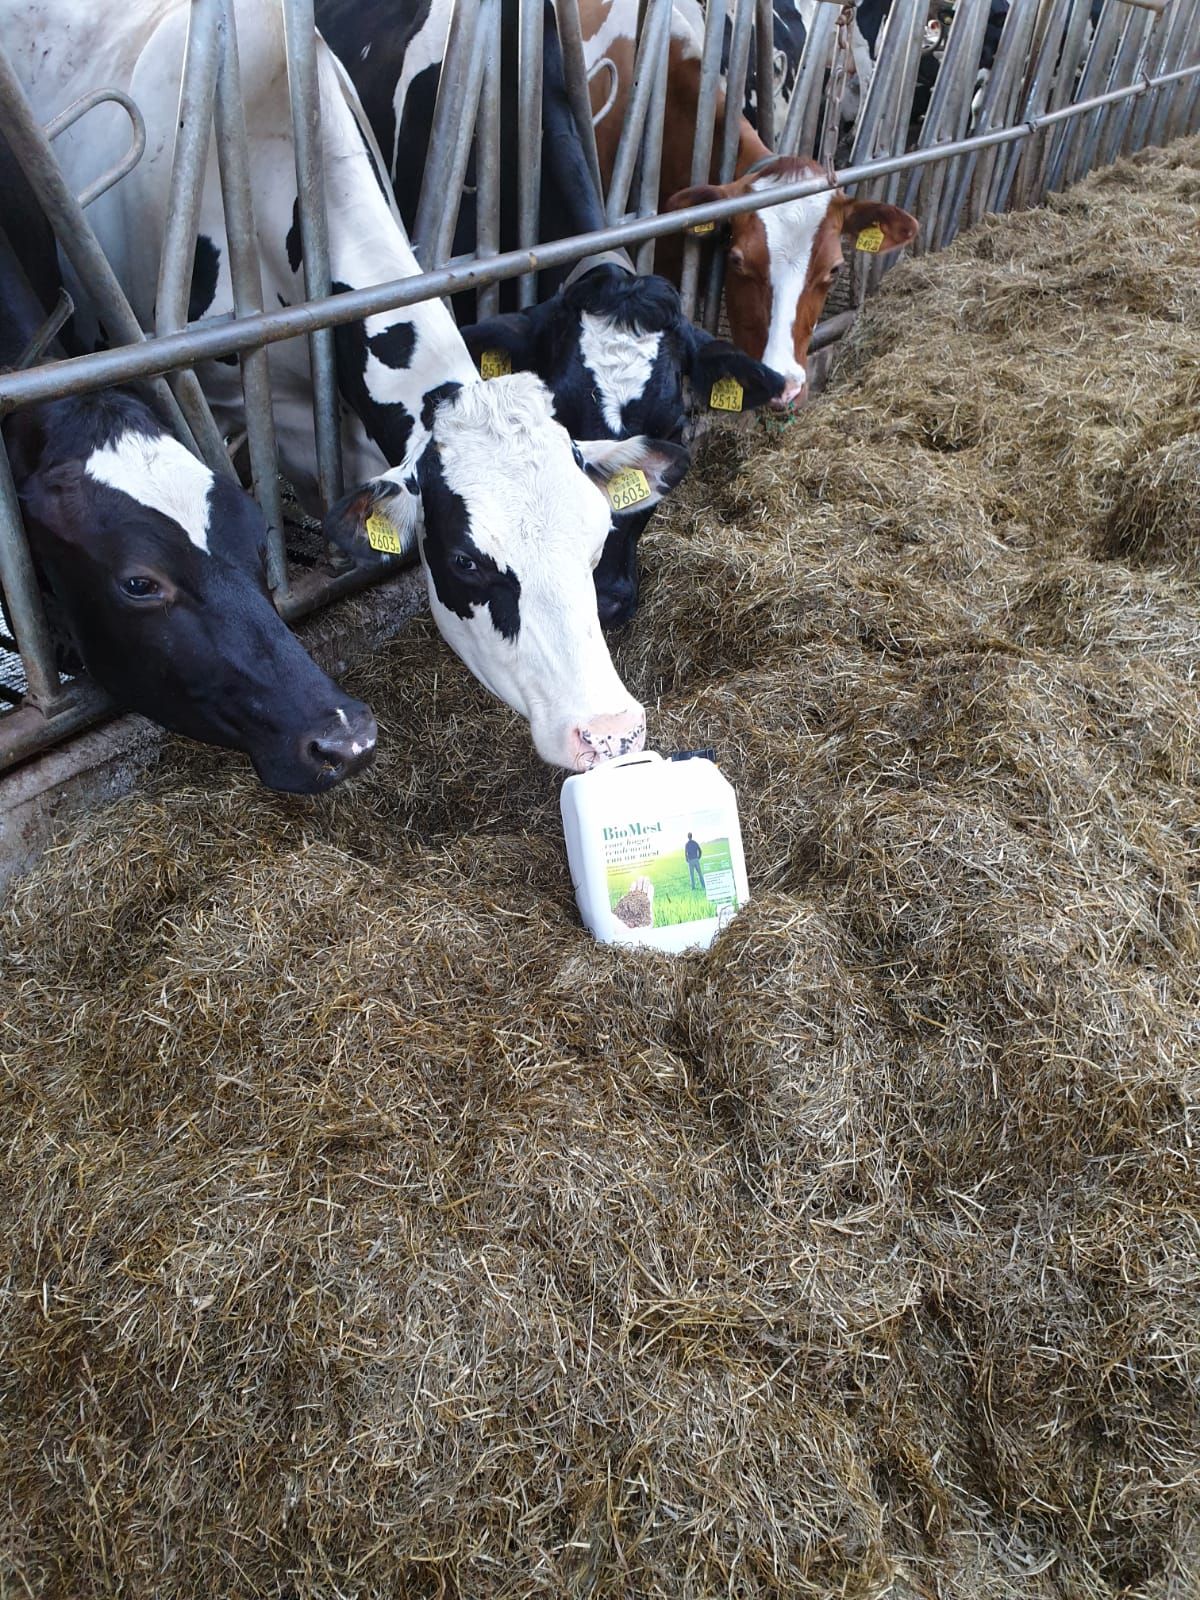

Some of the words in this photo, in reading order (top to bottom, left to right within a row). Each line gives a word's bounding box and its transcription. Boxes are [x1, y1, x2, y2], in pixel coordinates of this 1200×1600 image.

[712, 392, 737, 410] 9513
[613, 483, 645, 509] 9603
[370, 531, 396, 552] 9603
[603, 821, 662, 841] BioMest
